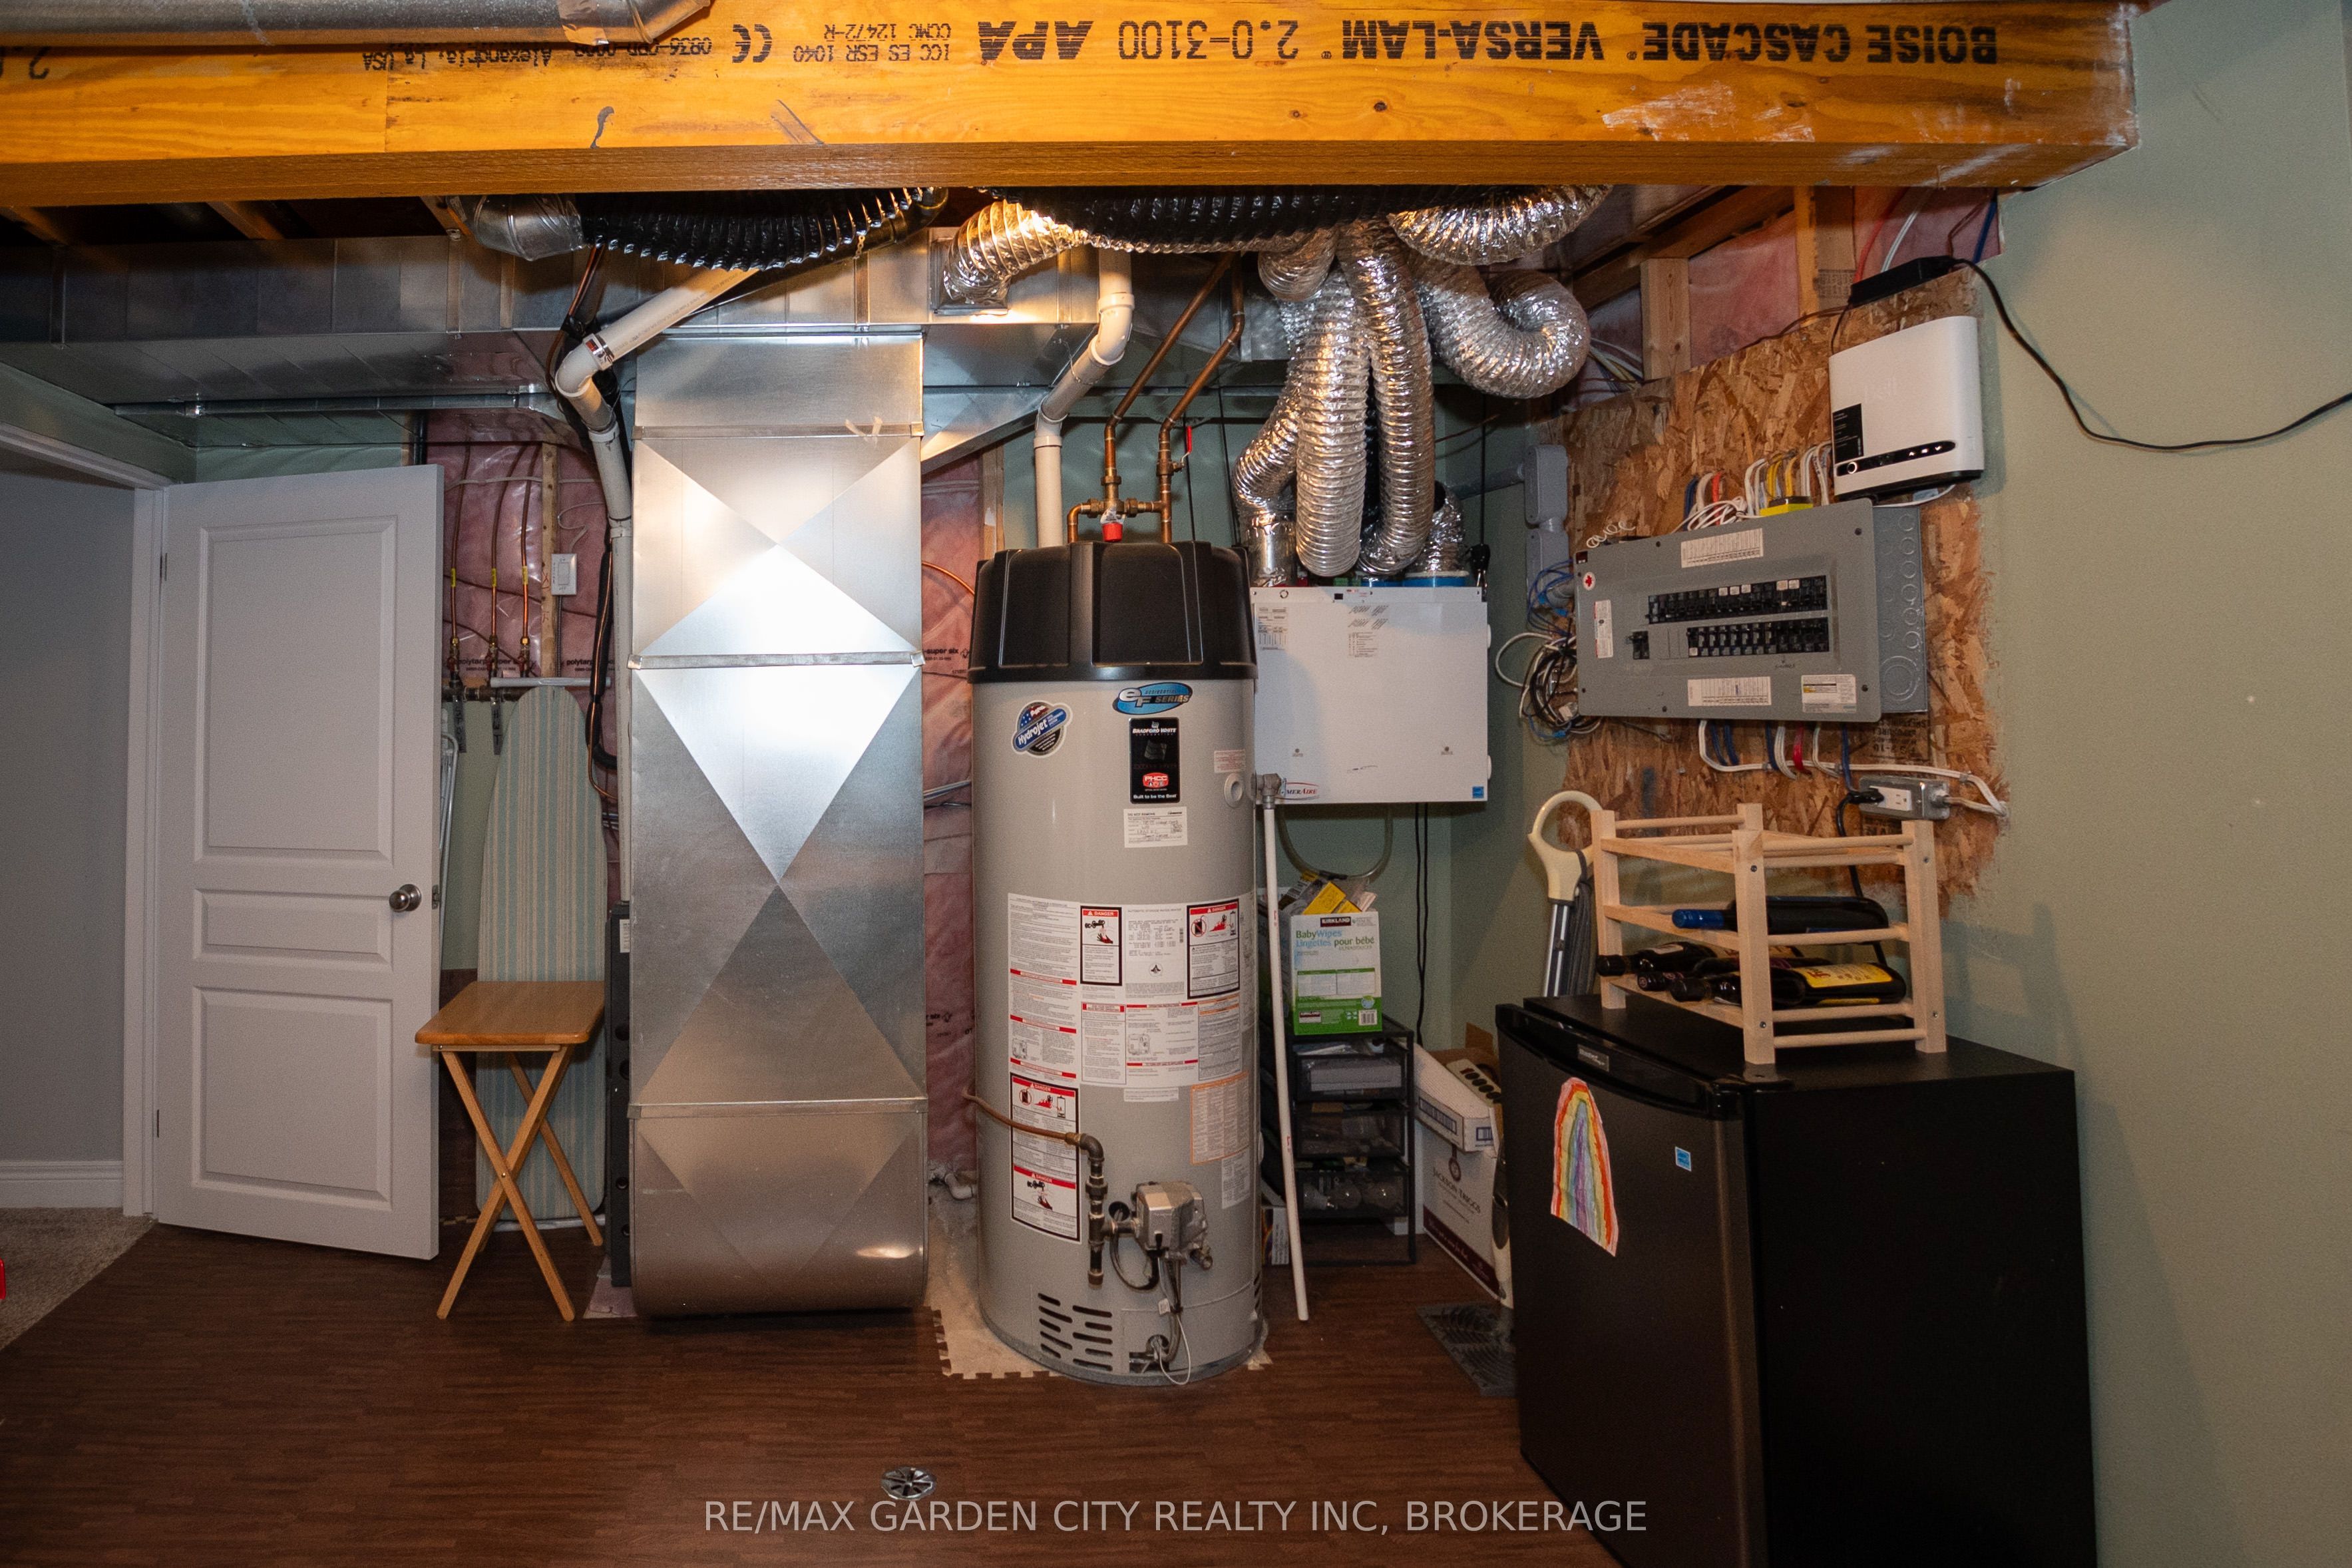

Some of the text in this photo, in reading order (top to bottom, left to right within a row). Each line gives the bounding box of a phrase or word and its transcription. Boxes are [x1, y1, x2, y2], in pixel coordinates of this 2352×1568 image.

[823, 23, 952, 41] CCMC 12472-R
[1118, 19, 1300, 60] 2.0-3100
[793, 44, 950, 63] ICC ES ESR 1040
[1867, 25, 1997, 64] BOISE
[1018, 719, 1048, 745] Hydrojet
[1296, 940, 1331, 948] Lingettes
[1334, 938, 1353, 948] pour
[1355, 936, 1375, 945] bébé
